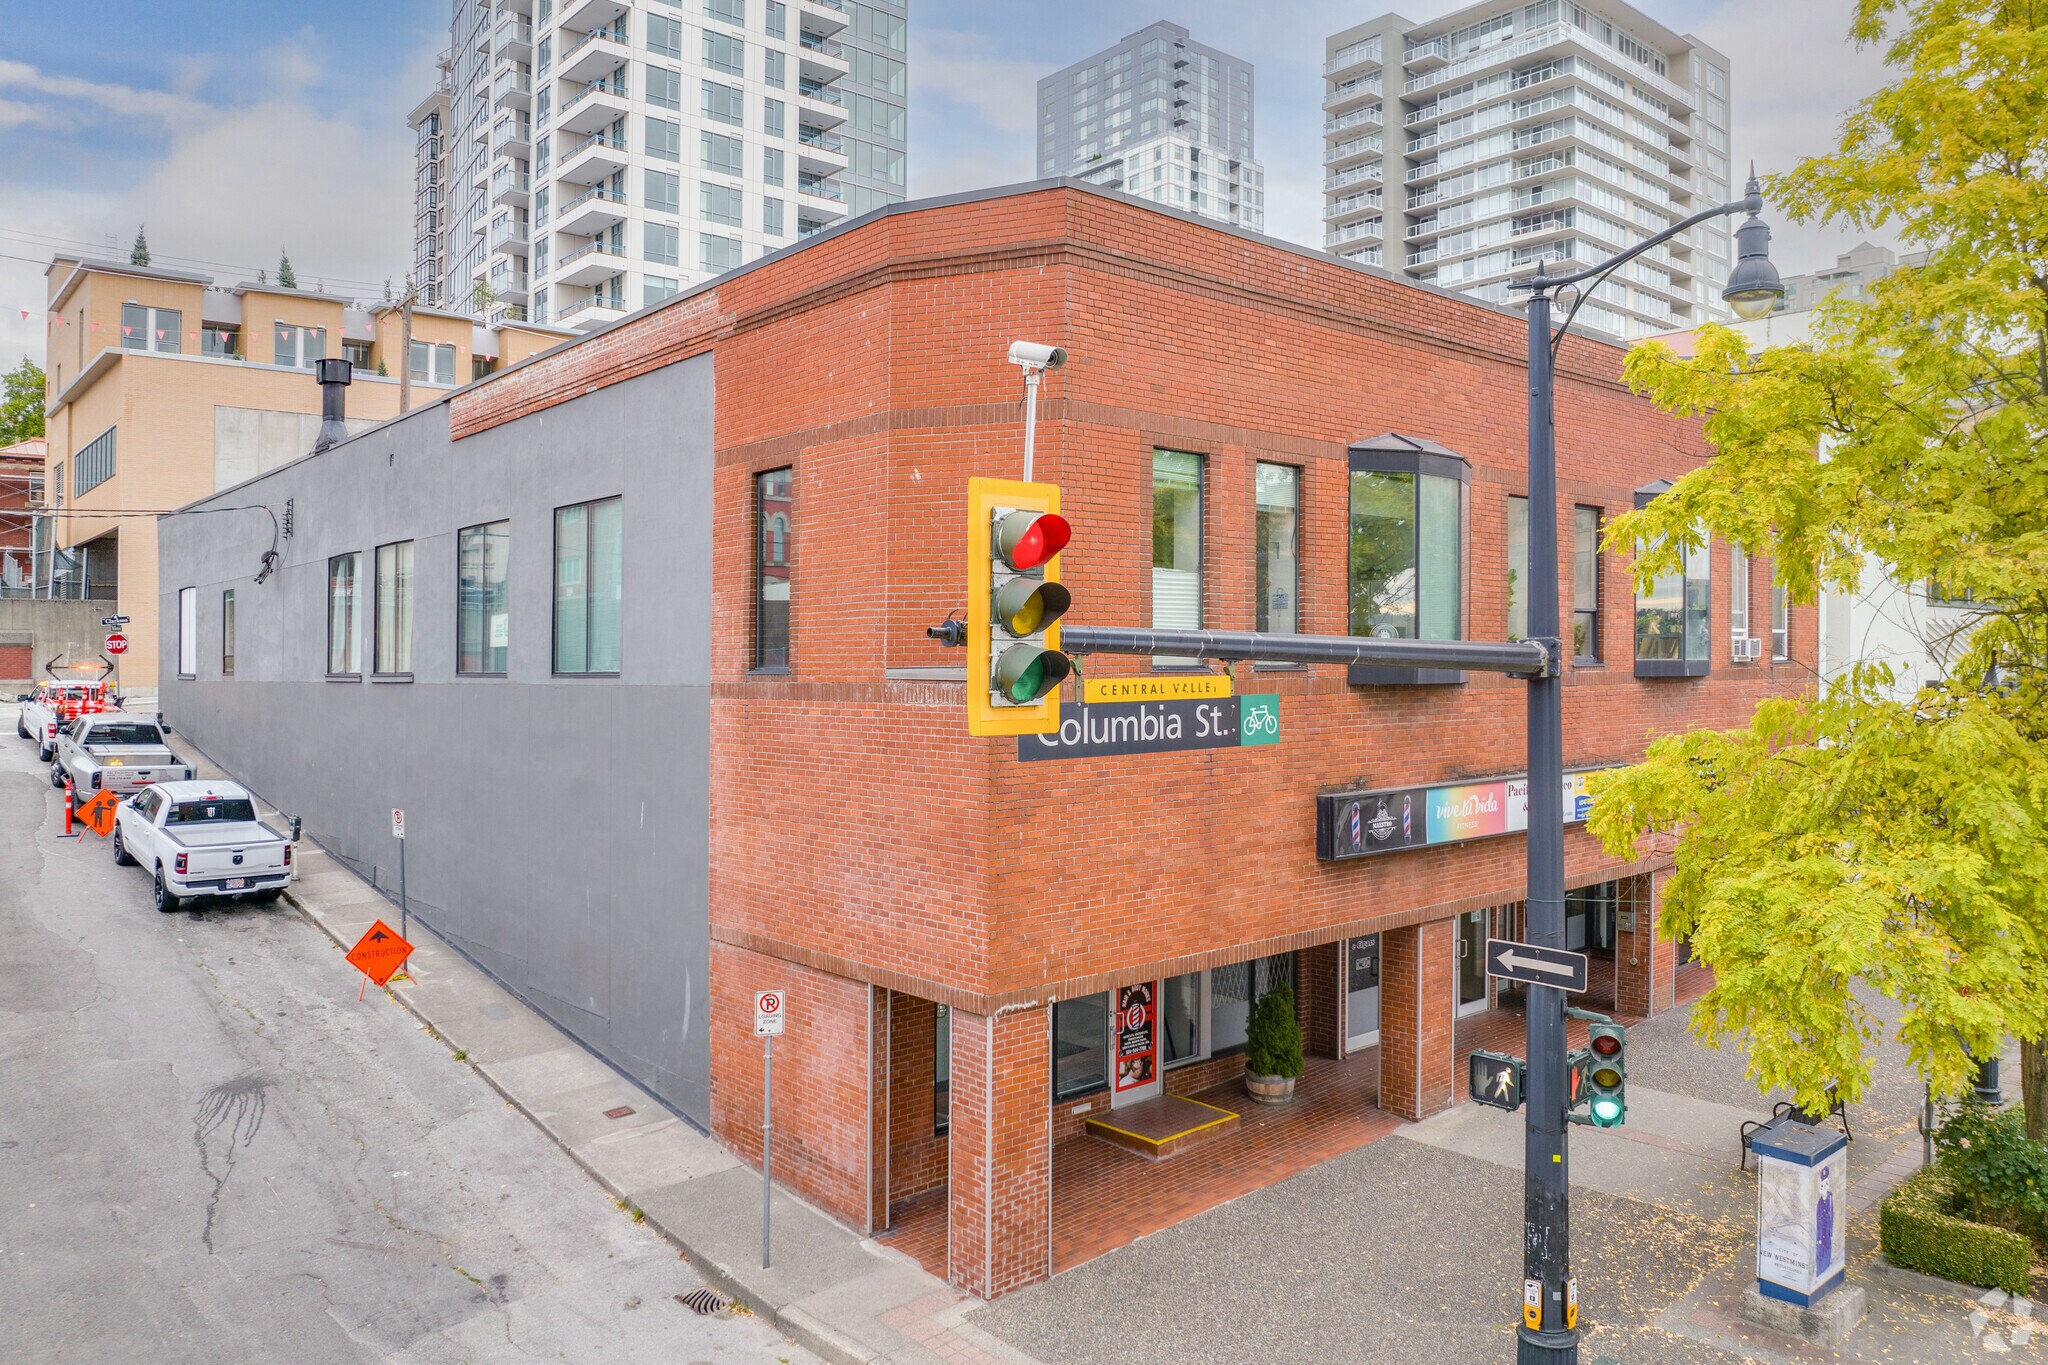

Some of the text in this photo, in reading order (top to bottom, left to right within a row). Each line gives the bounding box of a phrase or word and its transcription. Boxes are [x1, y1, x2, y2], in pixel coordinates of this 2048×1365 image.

[106, 640, 127, 649] STOP
[1100, 684, 1165, 696] CENTRAL
[1195, 704, 1228, 737] St.
[1457, 821, 1478, 829] FITNESS
[351, 947, 407, 960] CONSTRUCTION
